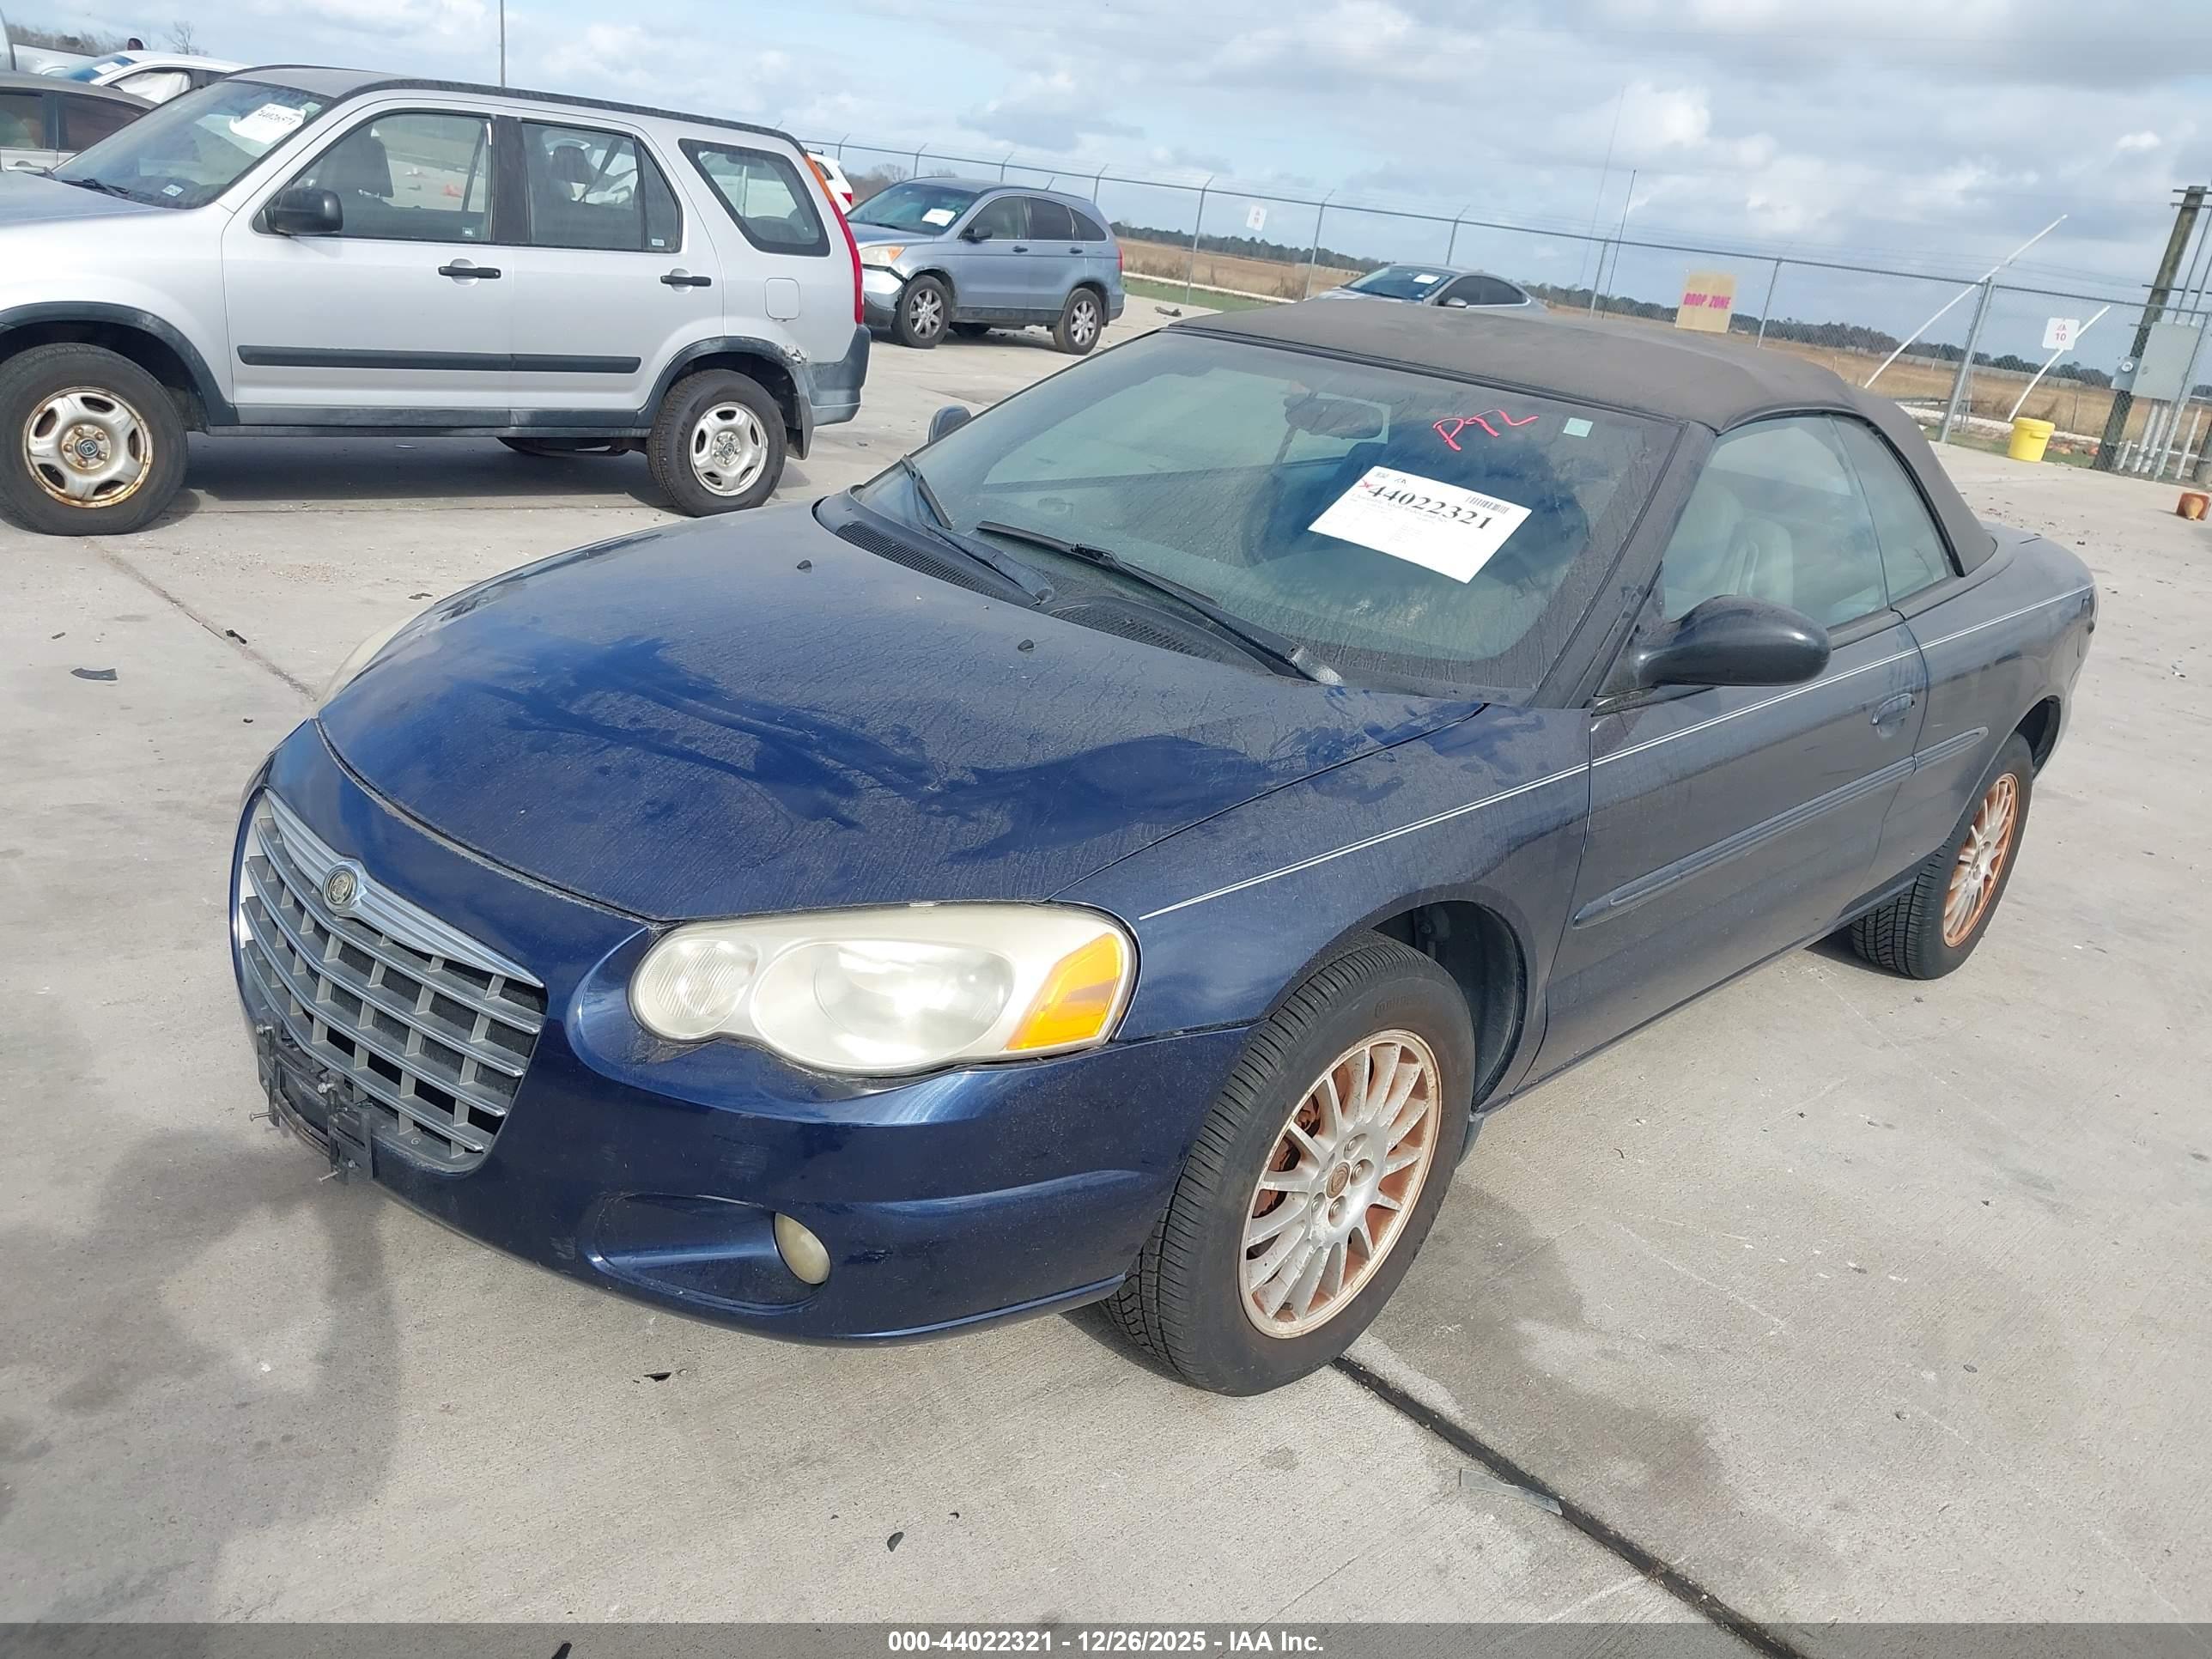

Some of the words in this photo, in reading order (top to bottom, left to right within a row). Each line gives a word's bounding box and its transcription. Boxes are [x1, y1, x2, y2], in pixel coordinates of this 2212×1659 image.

[1683, 292, 1706, 307] DROP
[1709, 295, 1731, 310] ZONE
[2055, 332, 2067, 342] 10
[1368, 485, 1492, 530] 44022321
